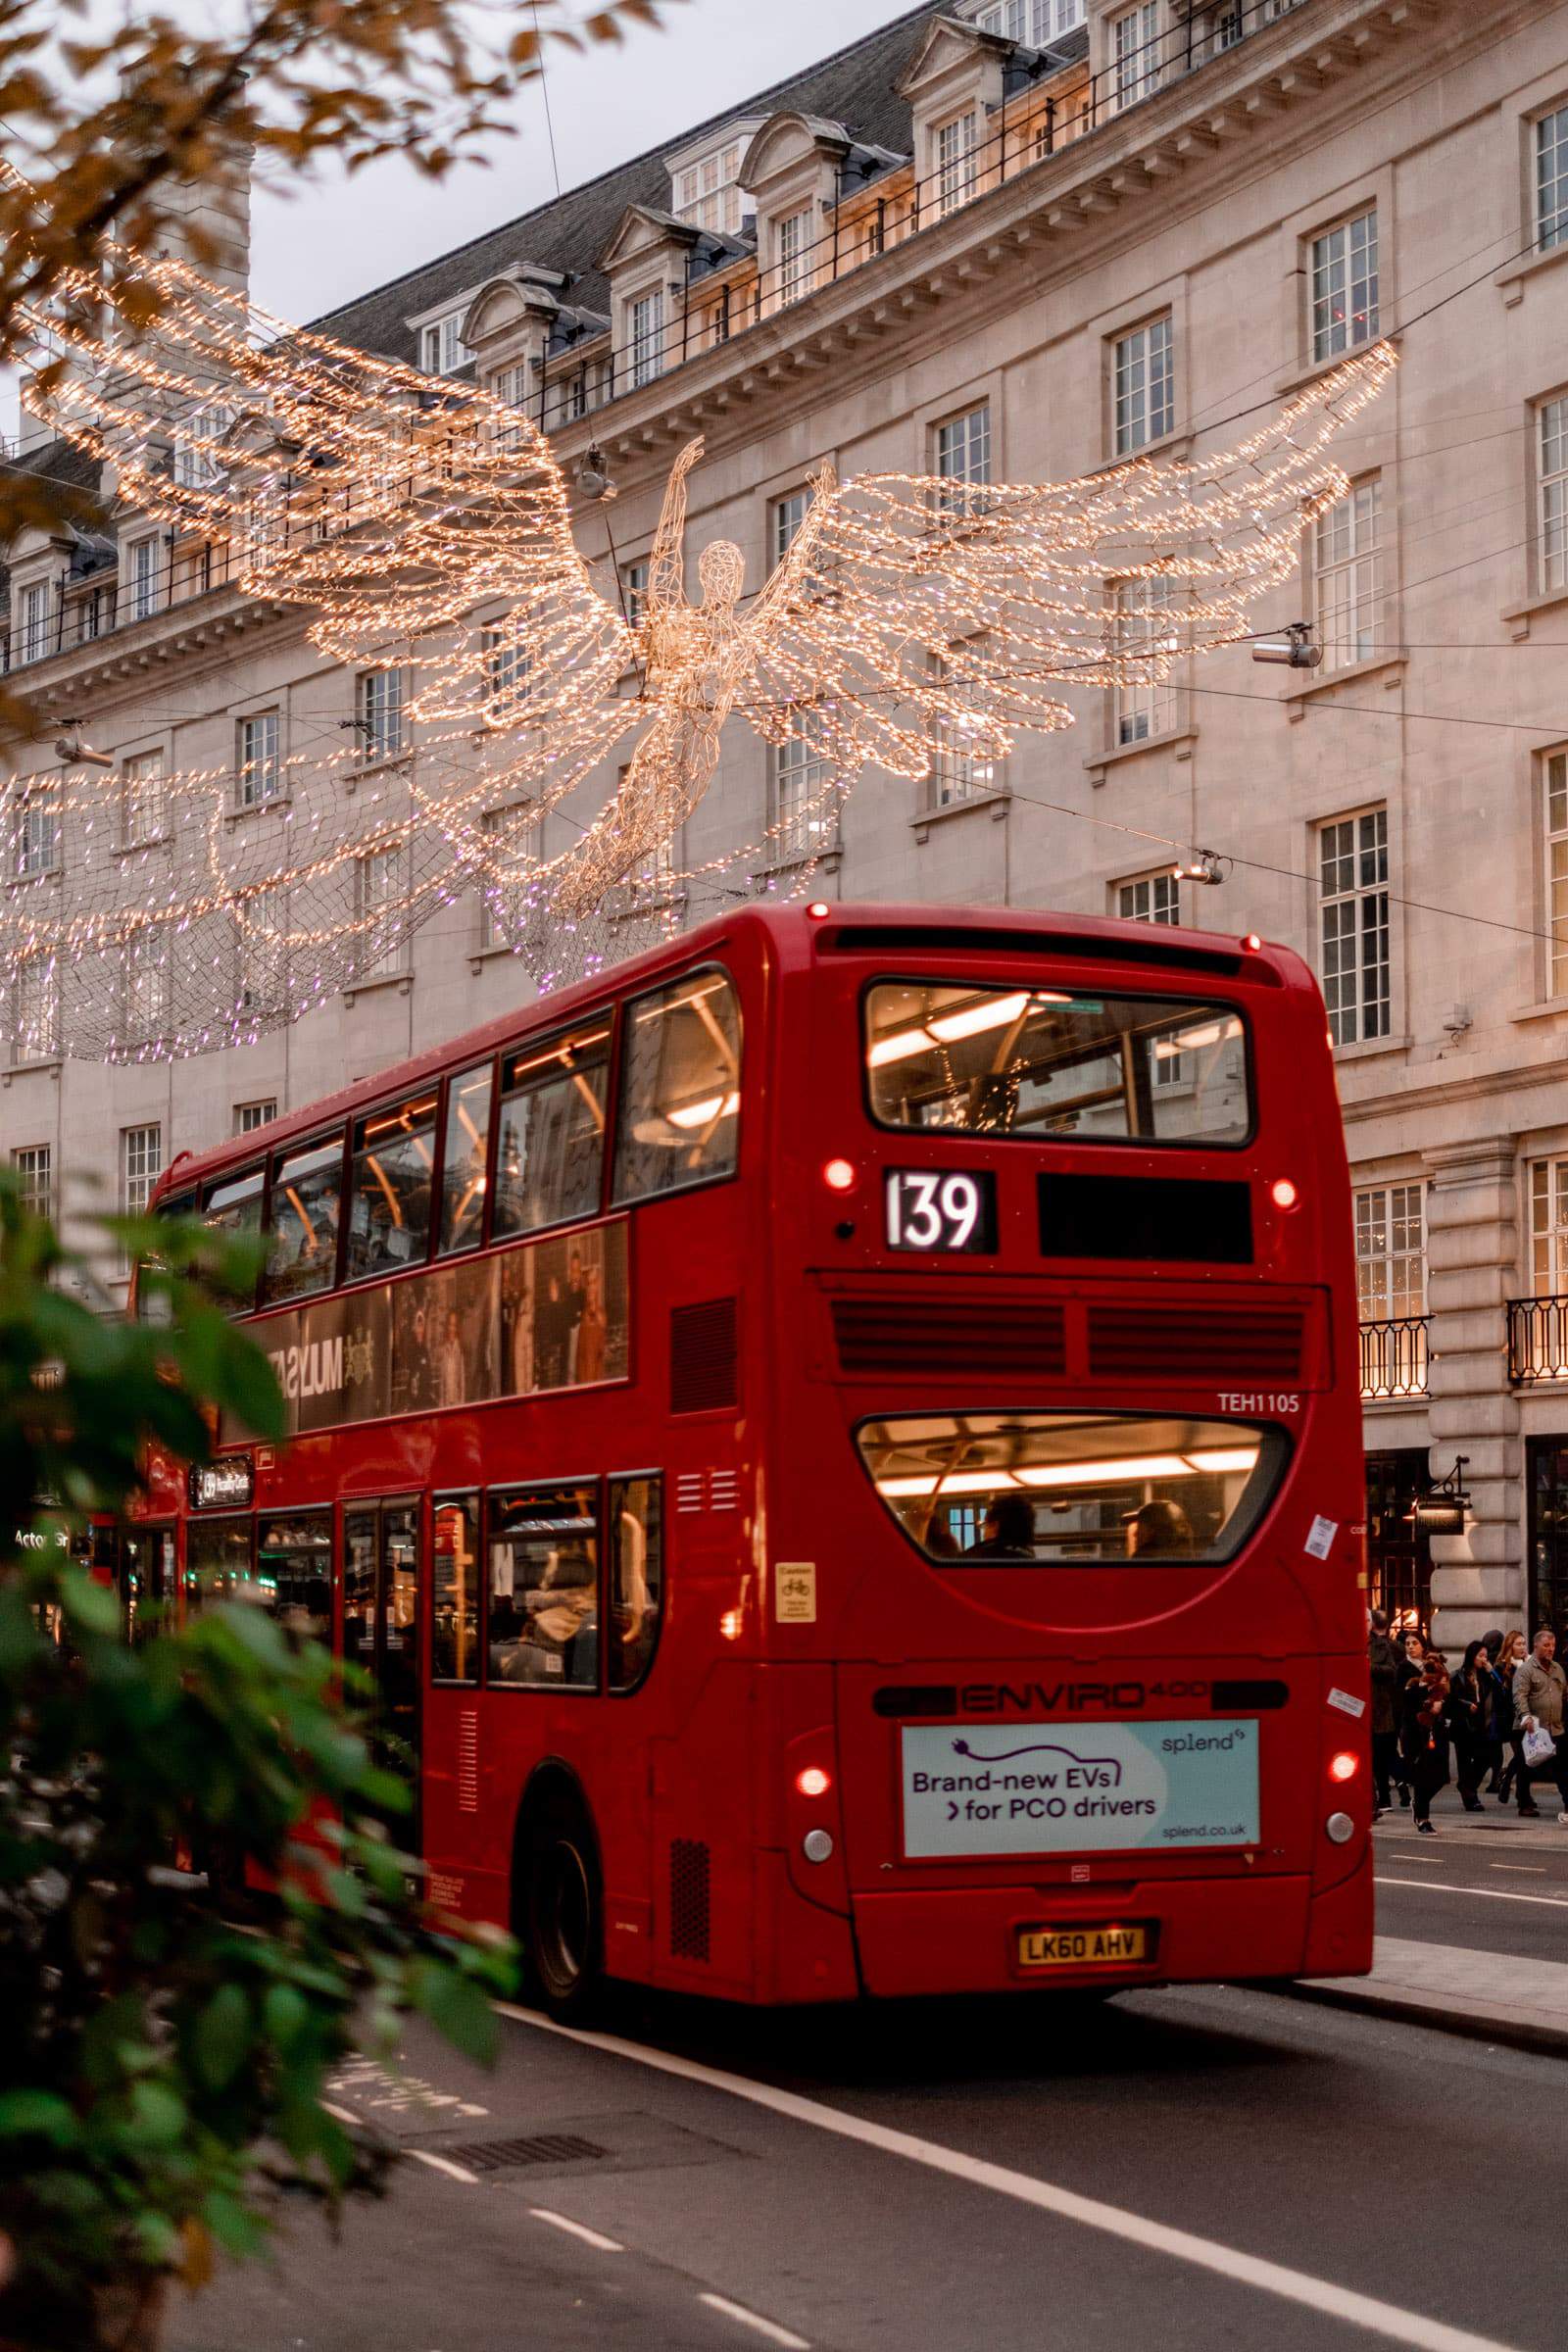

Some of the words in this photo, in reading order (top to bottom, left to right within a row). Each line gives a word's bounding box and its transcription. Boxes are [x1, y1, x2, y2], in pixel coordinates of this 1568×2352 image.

[887, 1174, 978, 1247] 139
[1216, 1394, 1299, 1412] TEH1105
[1161, 1734, 1233, 1752] splend
[913, 1770, 1057, 1792] Brand-new
[1066, 1768, 1110, 1788] EVs
[965, 1799, 1002, 1820] for
[1010, 1798, 1066, 1819] PCO
[1074, 1795, 1155, 1816] drivers
[1162, 1825, 1247, 1839] splend.co.uk
[1028, 1936, 1086, 1959] LK60
[1094, 1933, 1134, 1955] AHV
